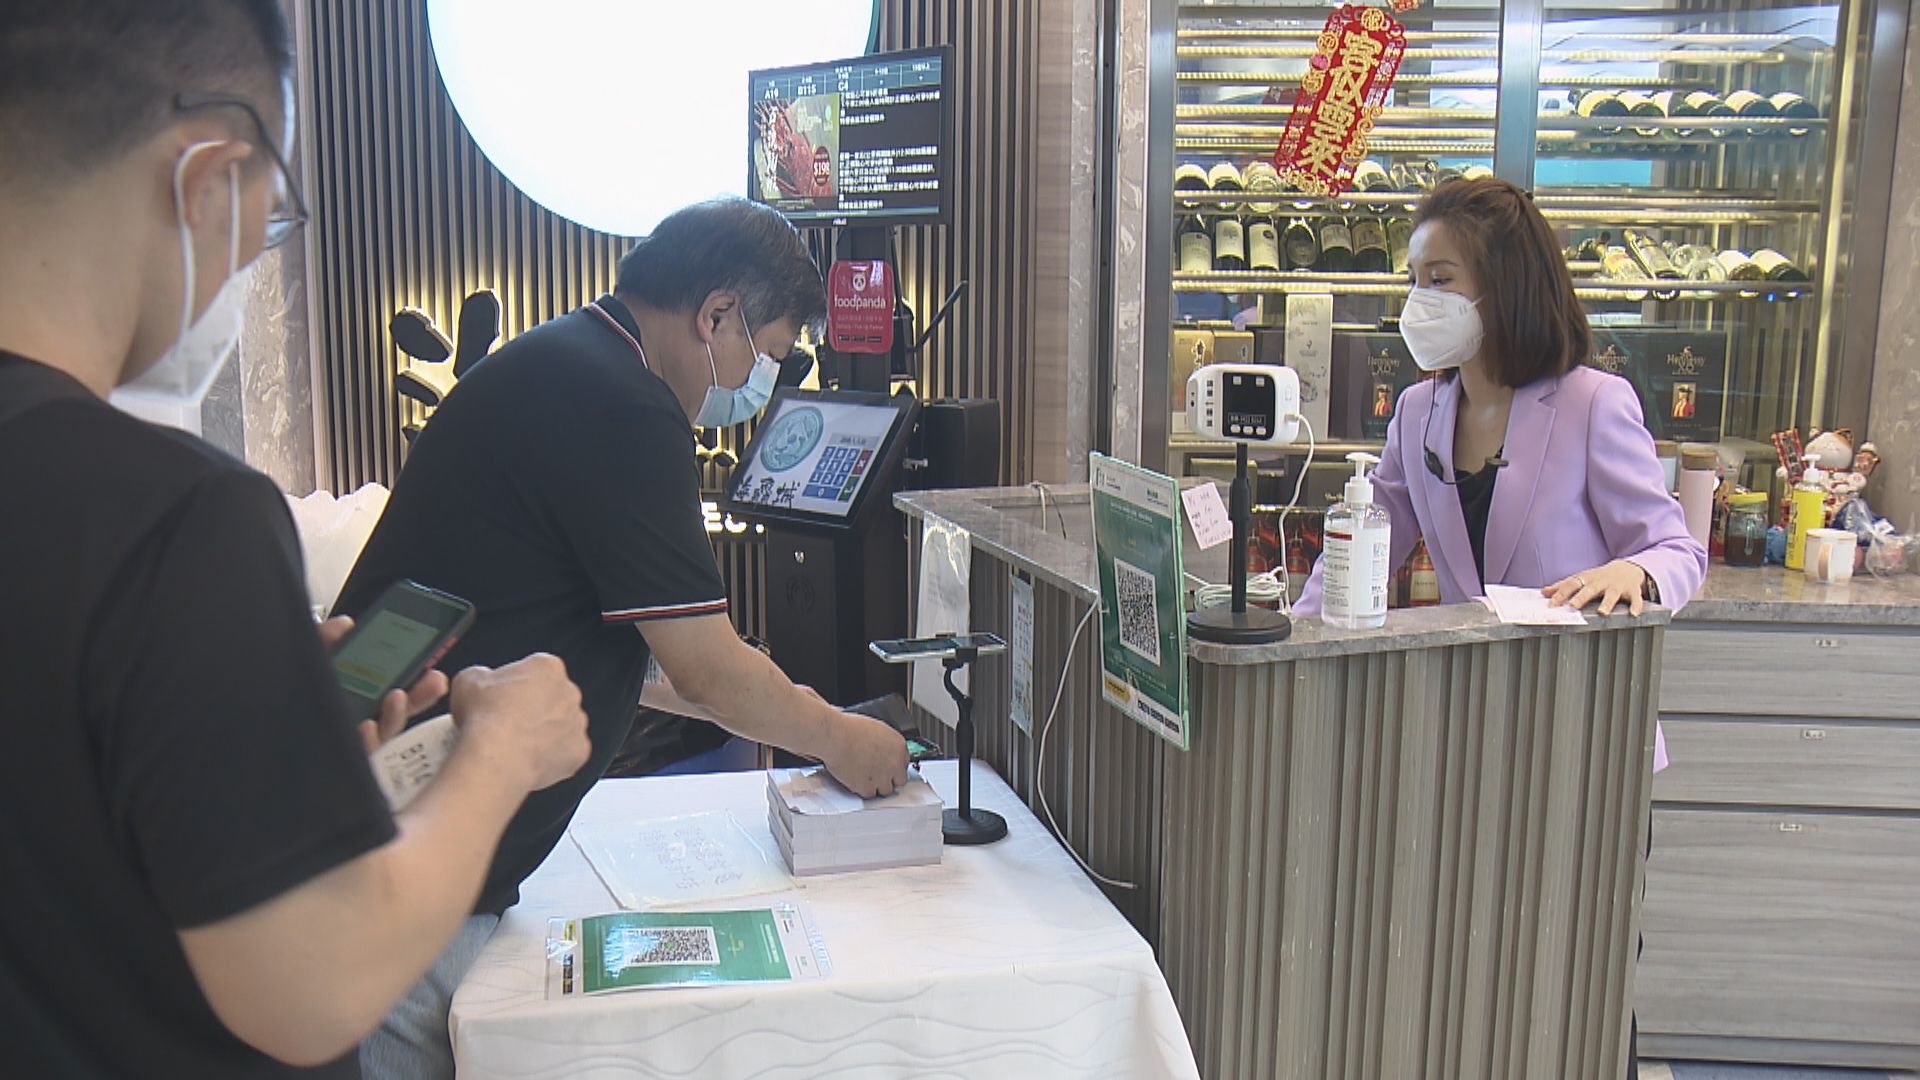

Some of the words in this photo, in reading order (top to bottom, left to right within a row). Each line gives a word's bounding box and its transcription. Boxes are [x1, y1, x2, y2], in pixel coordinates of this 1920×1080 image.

[1296, 30, 1383, 177] 客似雲來
[834, 293, 886, 311] foodpanda
